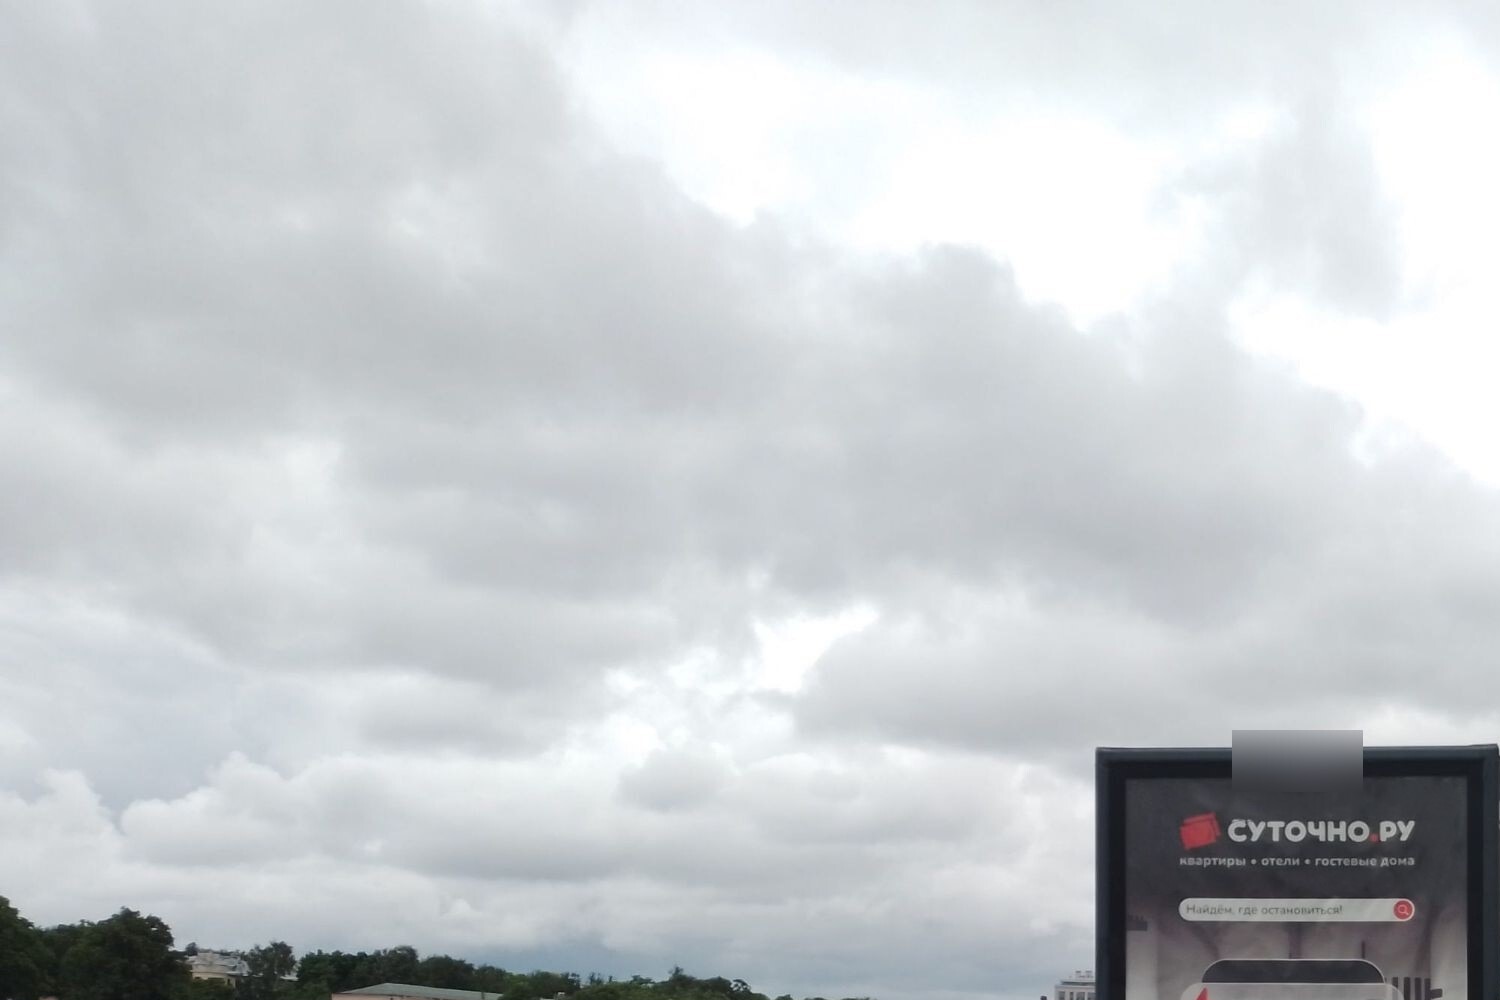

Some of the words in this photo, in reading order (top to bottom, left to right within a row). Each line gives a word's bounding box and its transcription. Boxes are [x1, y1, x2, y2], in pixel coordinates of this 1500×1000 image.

[1227, 819, 1416, 843] СУТОЧНО.РУ
[1179, 856, 1246, 868] квартиры
[1260, 856, 1301, 867] отели
[1314, 856, 1378, 867] гостевые
[1380, 856, 1416, 868] дома
[1237, 904, 1258, 917] где
[1260, 904, 1343, 916] остановиться!
